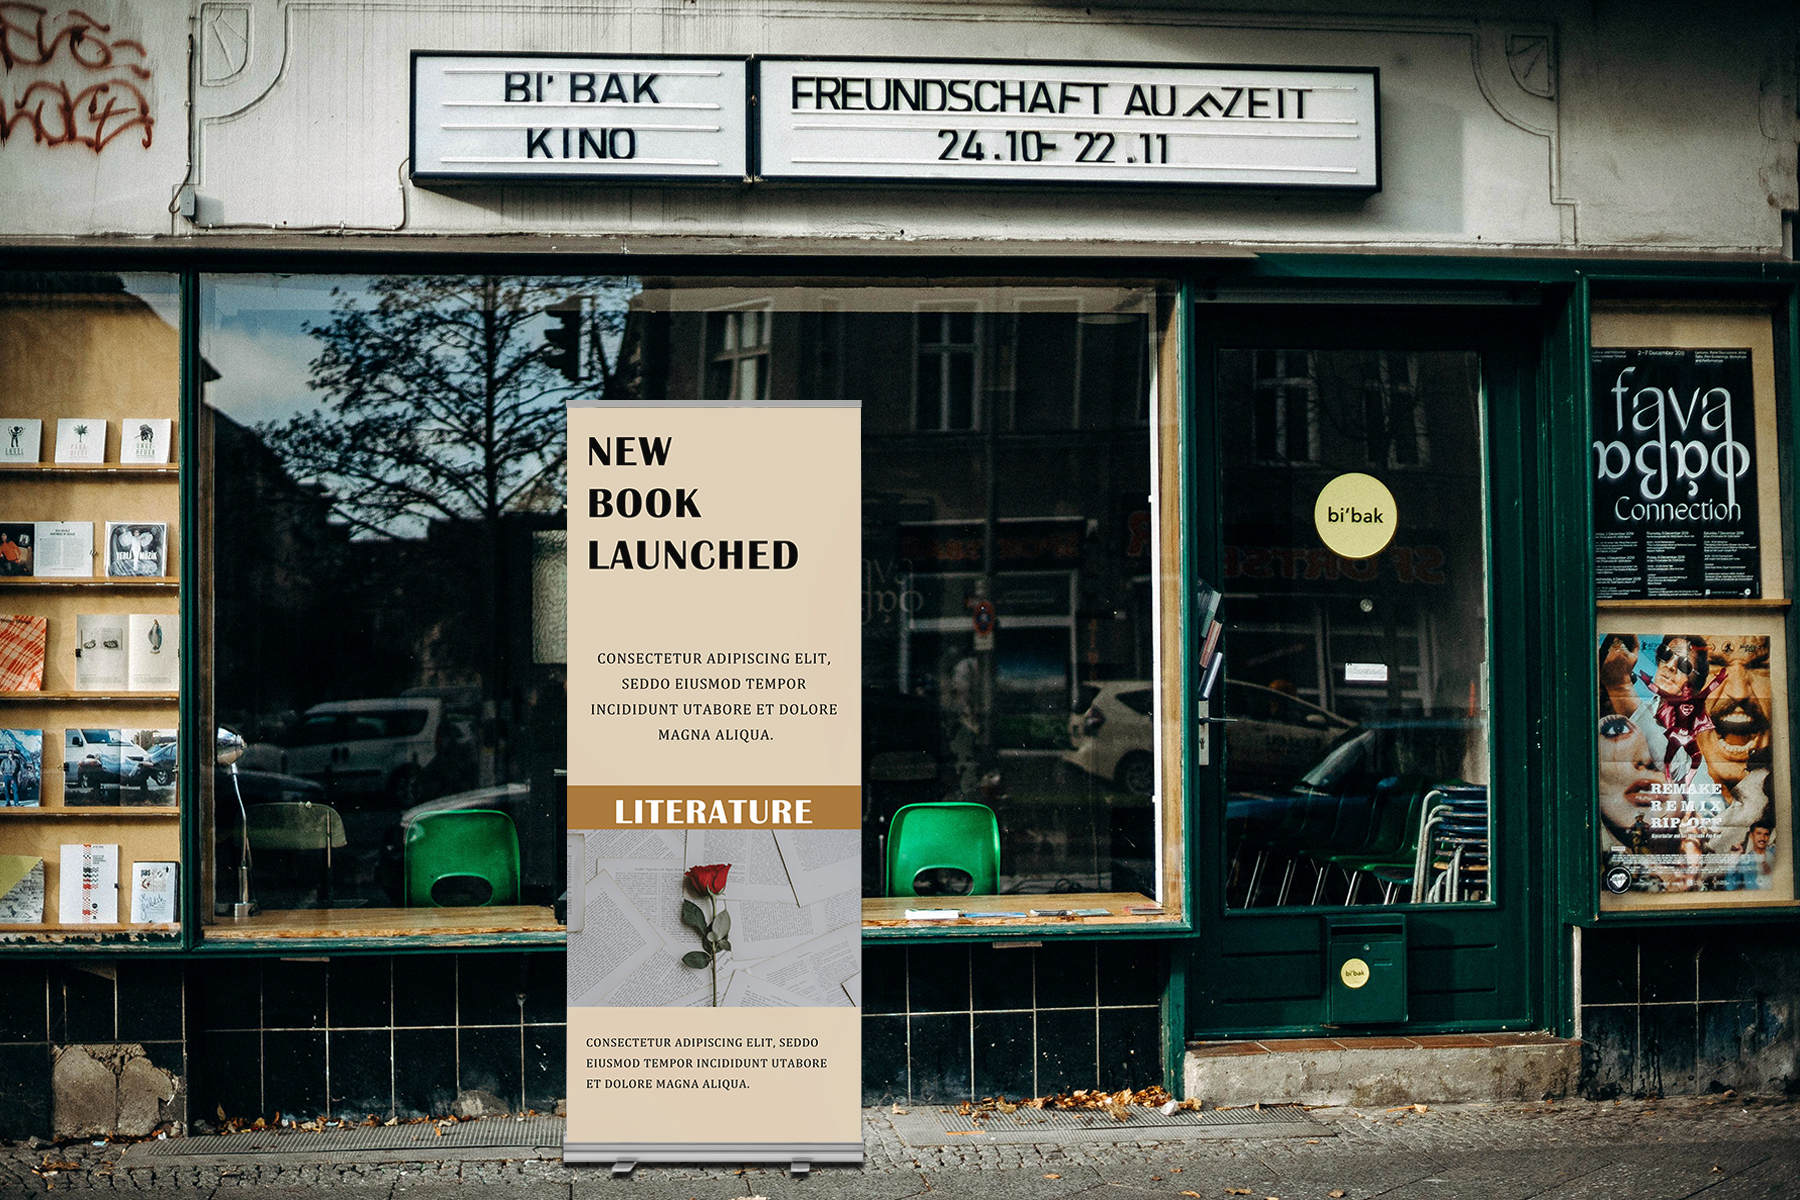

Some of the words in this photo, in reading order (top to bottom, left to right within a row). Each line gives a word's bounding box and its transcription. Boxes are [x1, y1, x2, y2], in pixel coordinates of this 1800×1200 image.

[569, 72, 660, 104] BAK
[791, 75, 1110, 115] FREUNDSCHAFT
[526, 127, 636, 160] KINO
[588, 436, 672, 466] NEW
[588, 487, 702, 518] BOOK
[1615, 496, 1742, 522] Connection
[588, 540, 799, 570] LAUNCHED
[597, 652, 702, 665] CONSECTETUR
[706, 652, 791, 665] ADIPISCING
[794, 652, 832, 667] ELIT,
[621, 678, 670, 690] SEDDO
[675, 678, 742, 690] EIUSMOD
[745, 678, 807, 690] TEMPOR
[590, 703, 678, 716] INCIDIDUNT
[683, 703, 752, 716] UTABORE
[756, 703, 775, 716] ET
[779, 703, 839, 716] DOLORE
[658, 729, 711, 741] MAGNA
[715, 729, 774, 744] ALIQUA.
[1650, 783, 1722, 795] REMAKE
[615, 799, 814, 825] LITERATURE
[1650, 800, 1722, 812] REMIX
[586, 1037, 671, 1048] CONSECTETUR
[674, 1037, 743, 1048] ADIPISCING
[746, 1037, 777, 1050] ELIT,
[779, 1037, 819, 1048] SEDDO
[586, 1058, 640, 1069] EIUSMOD
[643, 1058, 693, 1069] TEMPOR
[697, 1058, 768, 1069] INCIDIDUNT
[771, 1058, 828, 1069] UTABORE
[586, 1079, 601, 1090] ET
[605, 1079, 653, 1090] DOLORE
[656, 1079, 699, 1090] MAGNA
[702, 1079, 750, 1092] ALIQUA.
